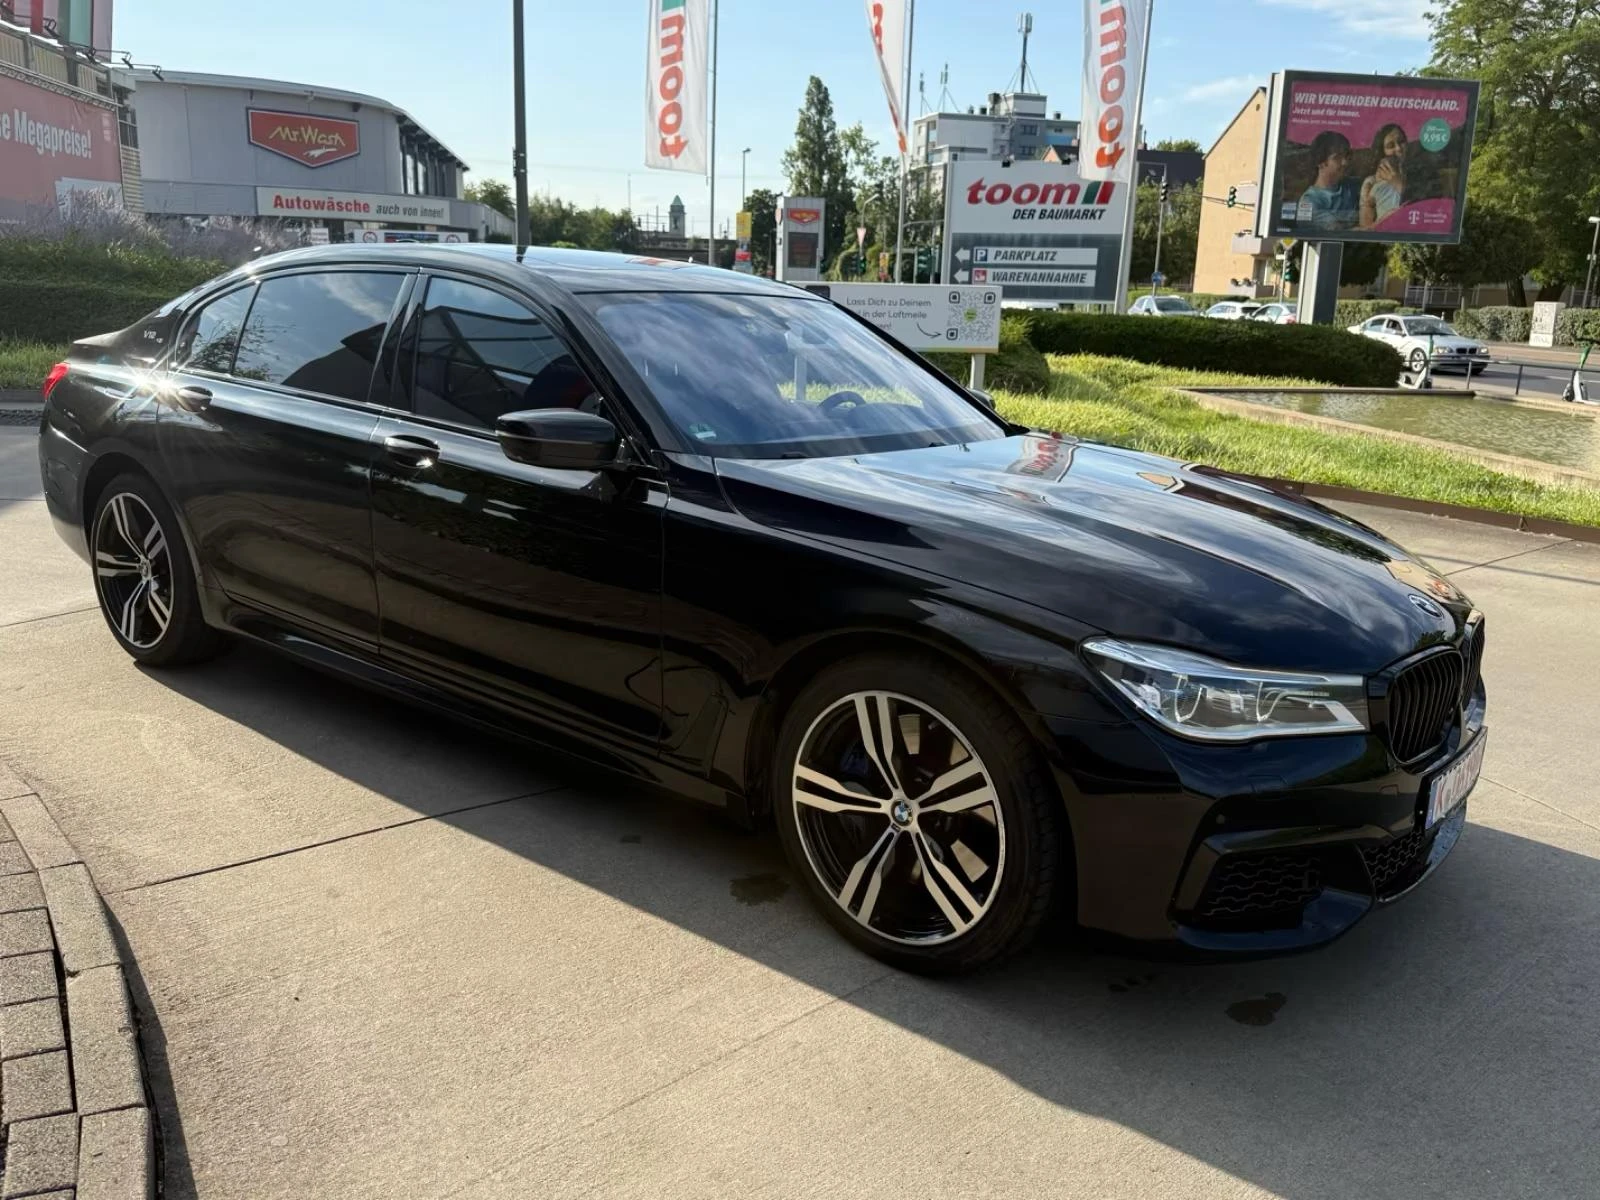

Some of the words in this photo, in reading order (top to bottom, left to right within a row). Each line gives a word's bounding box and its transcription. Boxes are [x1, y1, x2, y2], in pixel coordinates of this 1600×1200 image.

[659, 14, 689, 159] toom
[1095, 5, 1126, 170] toom
[1294, 92, 1316, 105] WIR
[1318, 93, 1379, 108] VERBINDEN
[1379, 98, 1460, 112] DEUTSCHLAND.
[1292, 107, 1311, 116] Jetzt
[1311, 108, 1325, 116] und
[14, 108, 92, 159] Megapreise!
[967, 177, 1081, 205] toom
[273, 194, 370, 214] Autowäsche
[376, 203, 400, 215] auch
[402, 206, 418, 216] von
[420, 205, 444, 219] innen!
[1012, 208, 1035, 220] DER
[1038, 209, 1106, 221] BAUMARKT
[993, 250, 1058, 262] PARKPLATZ
[991, 271, 1087, 284] WARENANNAHME
[868, 297, 886, 306] Dich
[888, 299, 898, 307] zu
[899, 298, 932, 307] Deinem
[872, 310, 885, 318] der
